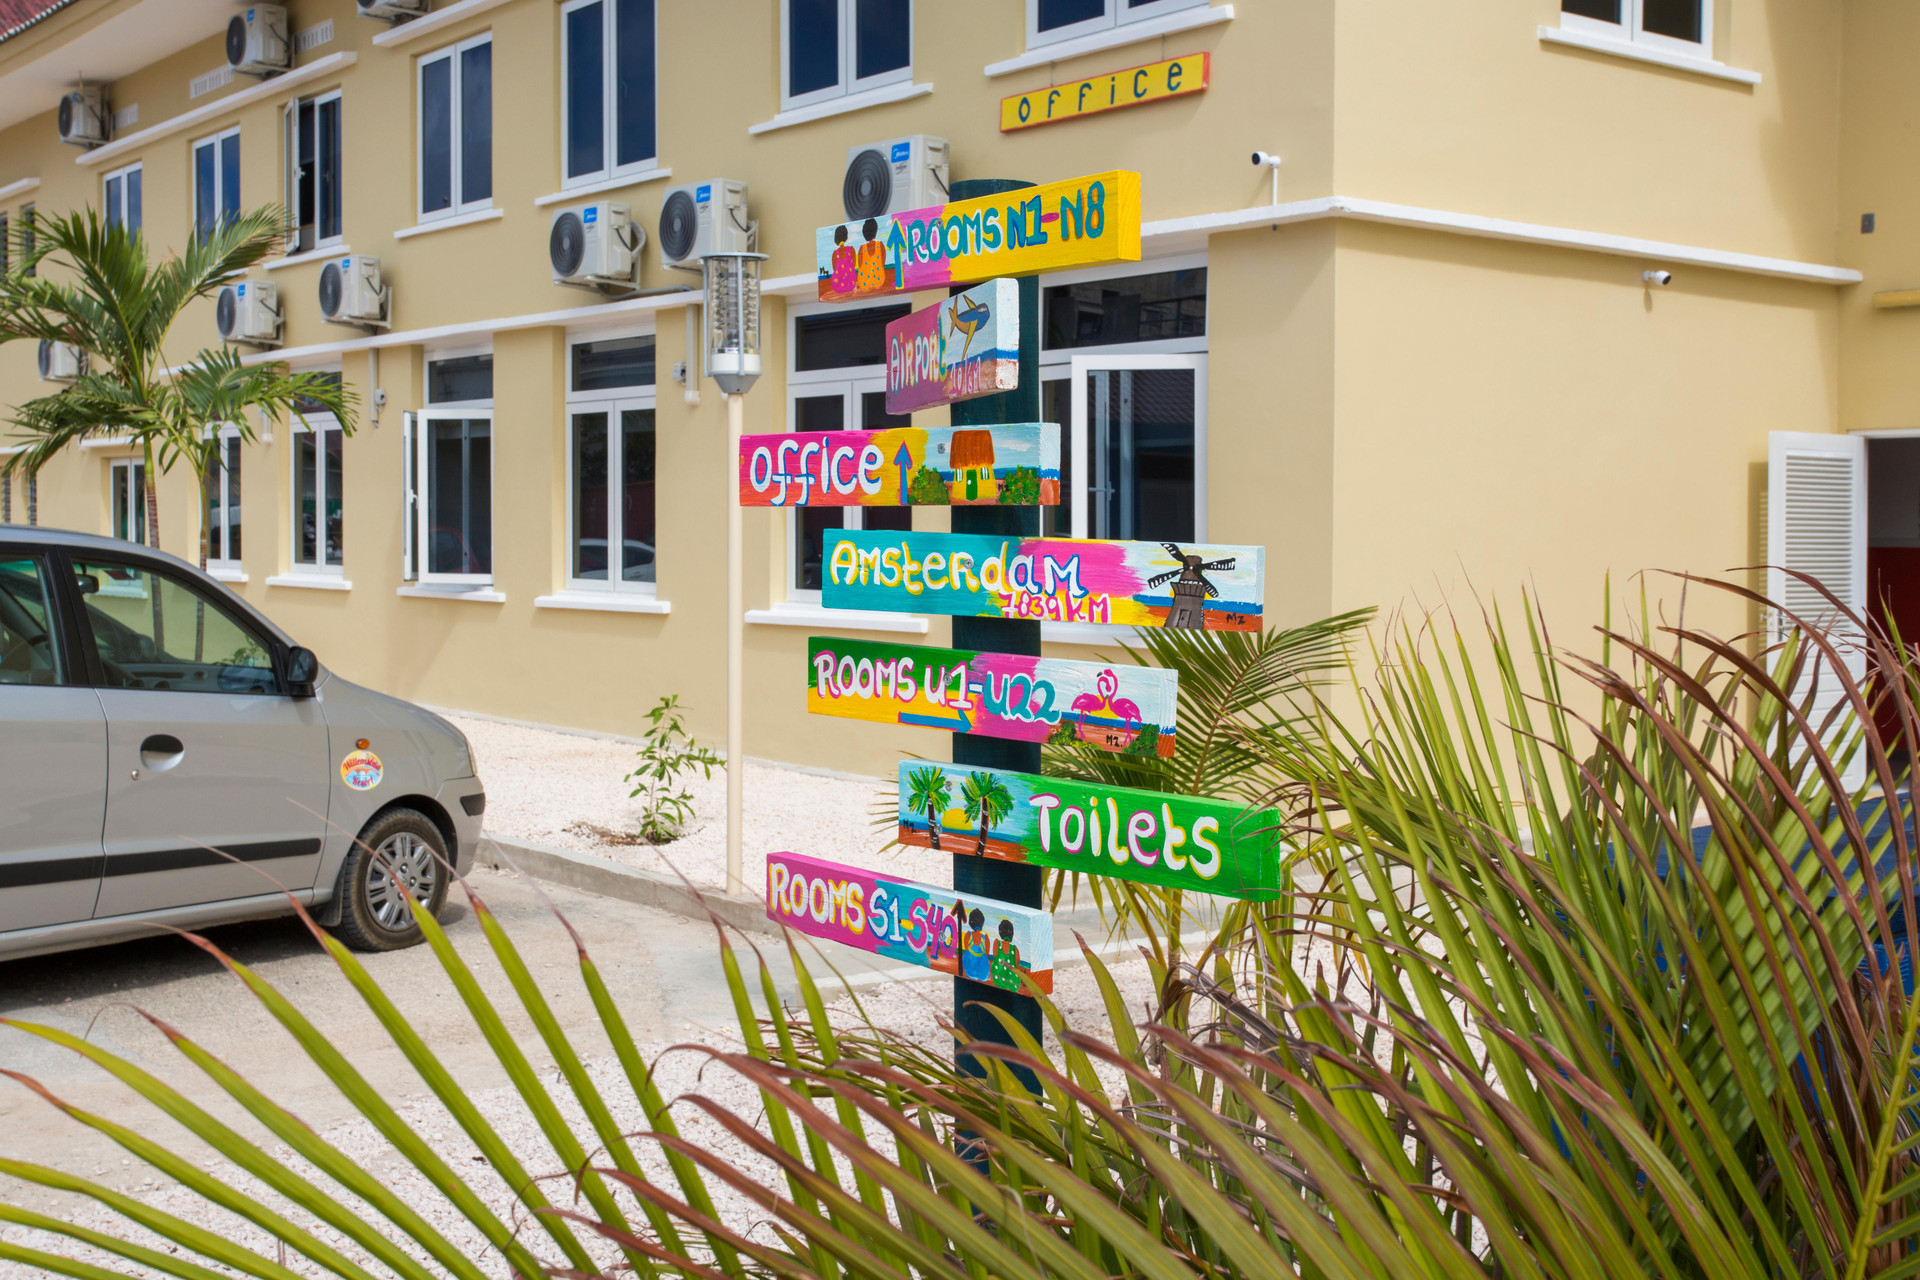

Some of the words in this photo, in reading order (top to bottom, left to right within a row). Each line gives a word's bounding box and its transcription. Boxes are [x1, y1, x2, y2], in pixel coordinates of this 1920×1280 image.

[906, 208, 1003, 266] ROOMS
[1006, 181, 1106, 250] N1-N8
[998, 590, 1063, 622] 7839
[813, 650, 917, 703] ROOMS
[1029, 792, 1221, 880] Toilets
[769, 863, 866, 935] ROOMS
